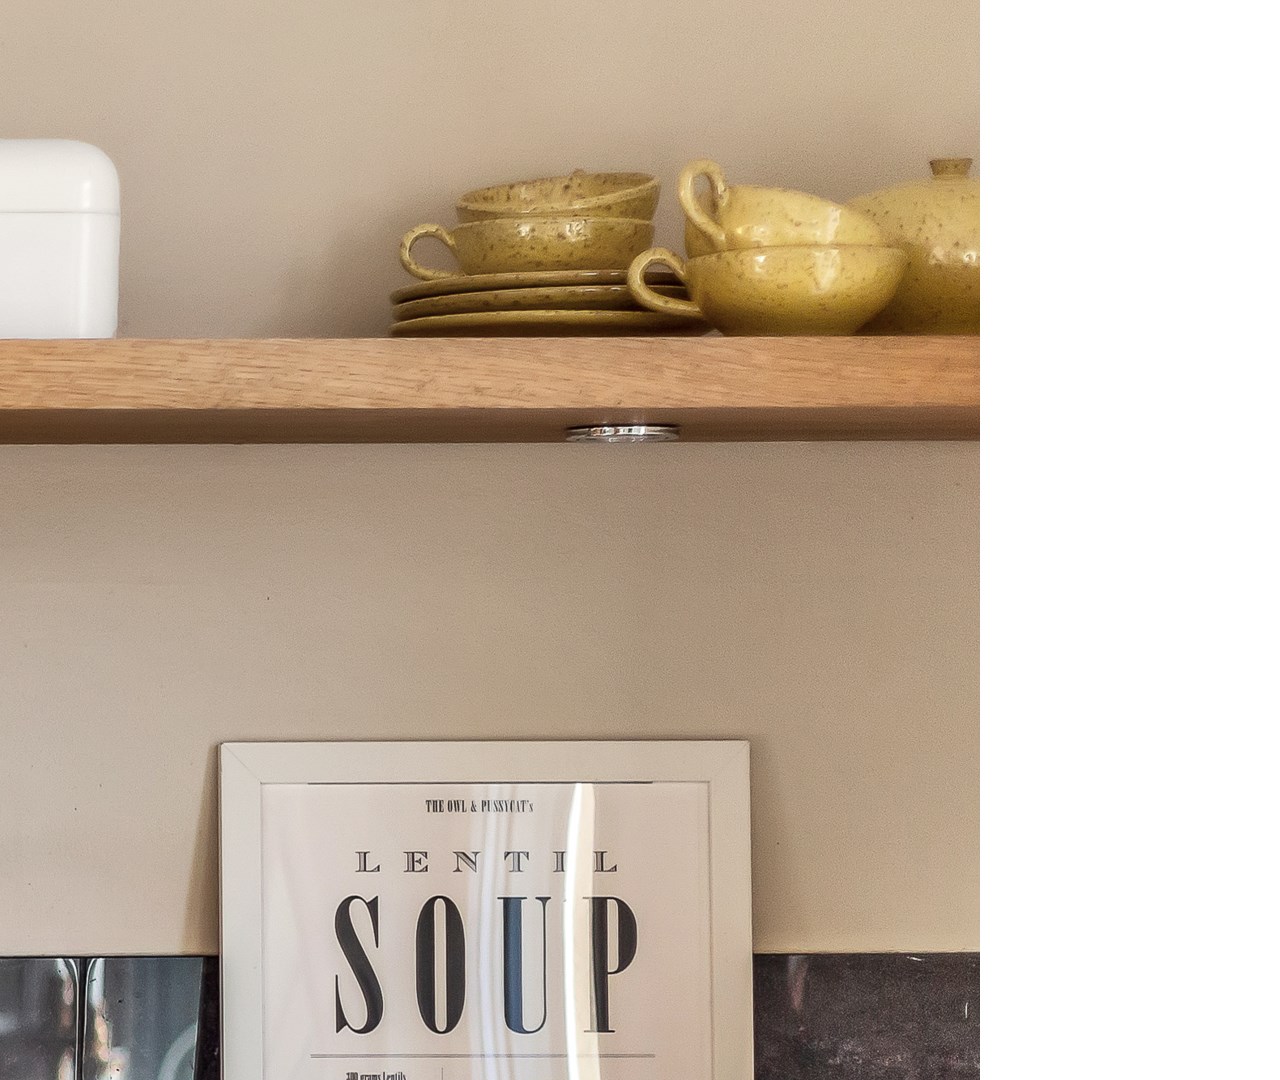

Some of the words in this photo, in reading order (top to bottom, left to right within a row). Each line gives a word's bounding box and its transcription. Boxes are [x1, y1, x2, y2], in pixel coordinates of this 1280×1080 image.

[426, 800, 444, 812] THE
[447, 800, 467, 812] OWL
[470, 801, 477, 812] &
[481, 800, 533, 813] PUSSYCAT's
[355, 850, 618, 873] LENTIL
[335, 894, 639, 1034] SOUP
